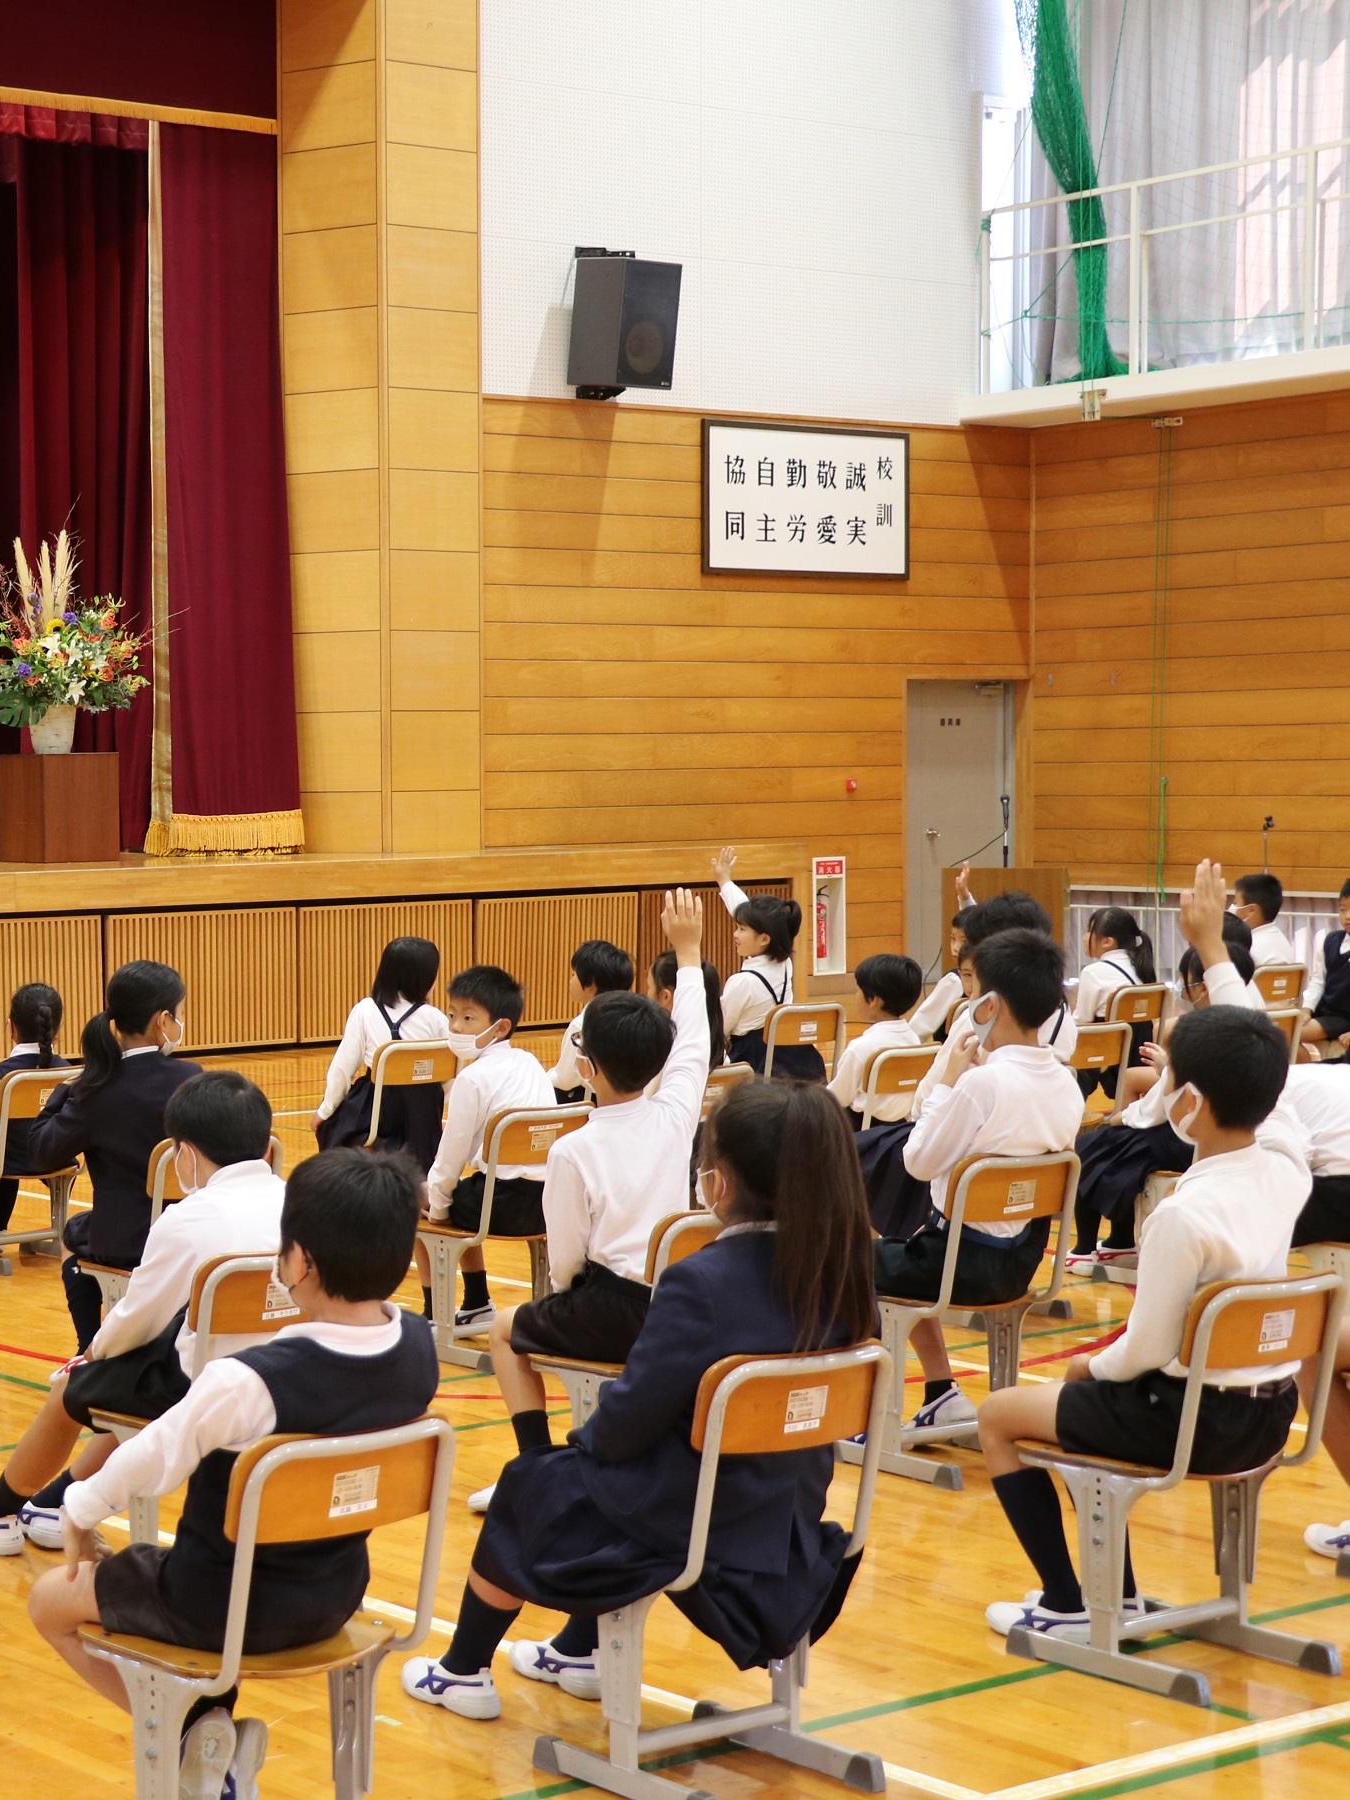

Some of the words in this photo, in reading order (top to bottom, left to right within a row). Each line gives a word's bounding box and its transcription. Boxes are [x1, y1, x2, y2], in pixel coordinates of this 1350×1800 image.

[724, 454, 746, 541] 協同
[756, 456, 777, 543] 自主
[785, 458, 808, 544] 勤労
[816, 459, 838, 545] 敬愛
[845, 461, 867, 546] 誠実
[876, 456, 893, 527] 校訓
[818, 865, 841, 874] 消火器
